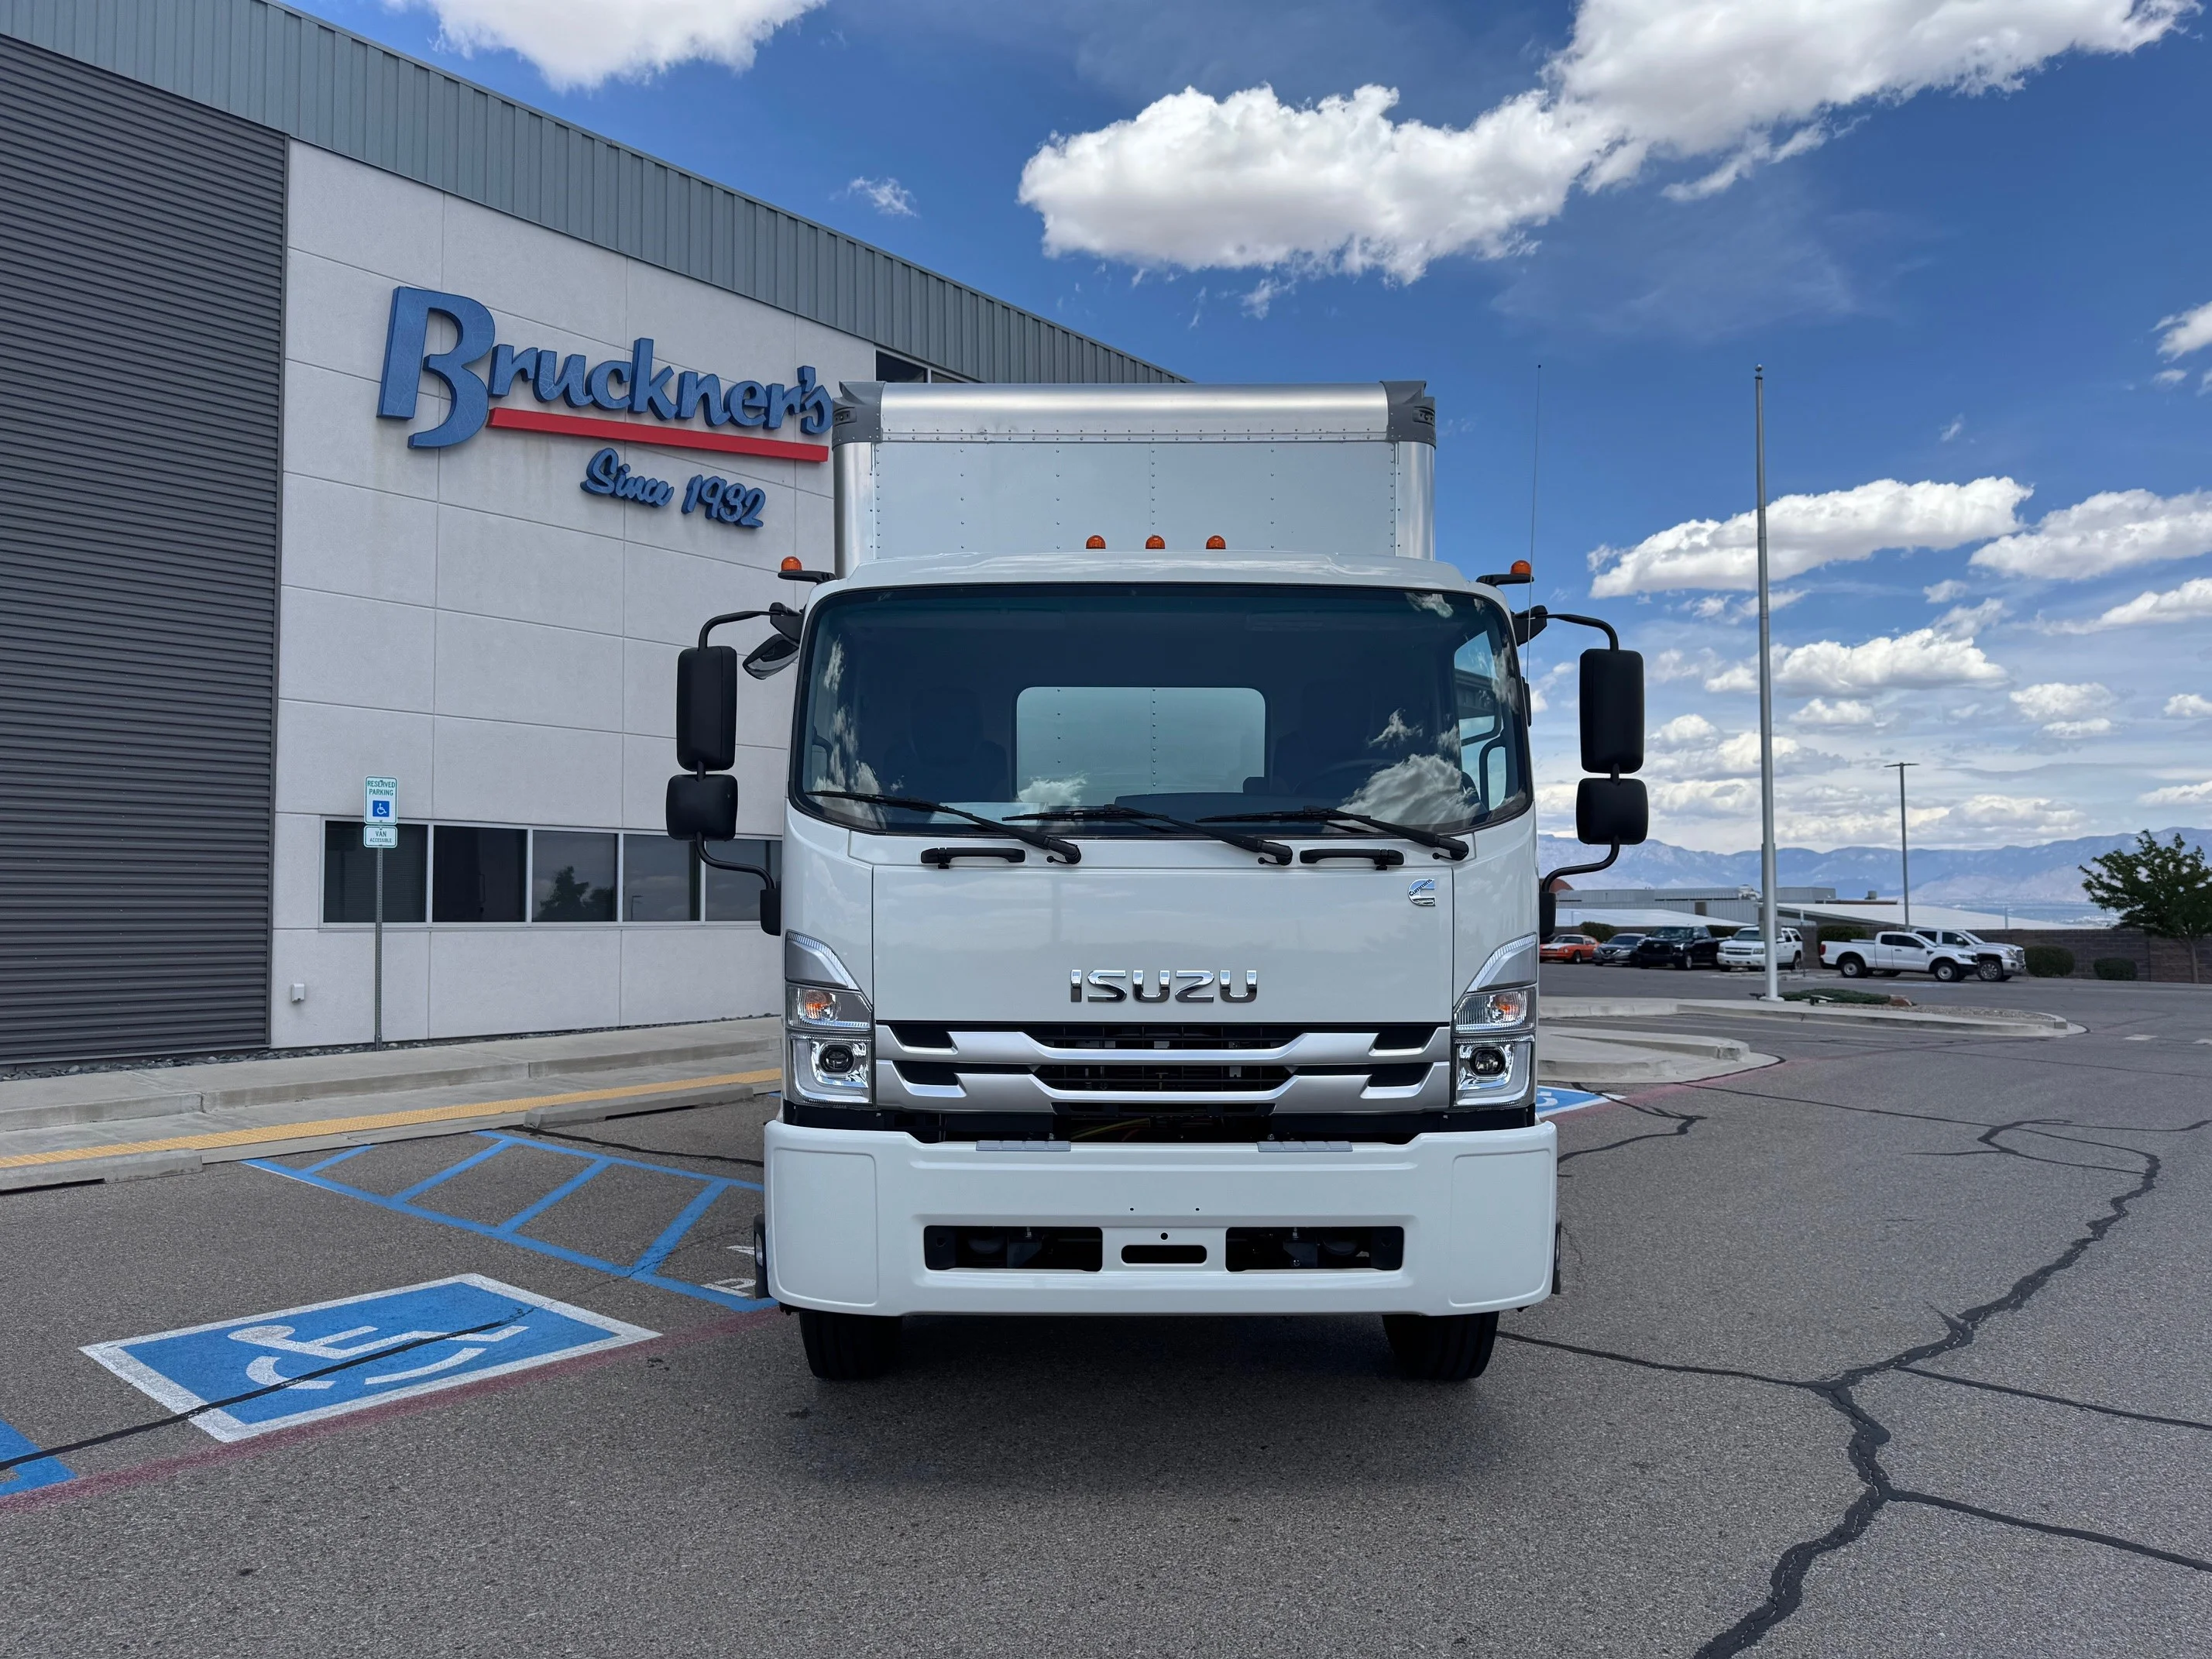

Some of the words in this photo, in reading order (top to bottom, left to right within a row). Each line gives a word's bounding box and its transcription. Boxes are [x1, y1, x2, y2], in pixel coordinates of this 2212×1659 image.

[376, 286, 833, 448] Bruckner's
[580, 448, 675, 509] Since
[681, 475, 766, 529] 1932
[367, 780, 396, 788] RESERVED
[1409, 878, 1433, 896] Cummins
[1070, 969, 1258, 1003] ISUZU
